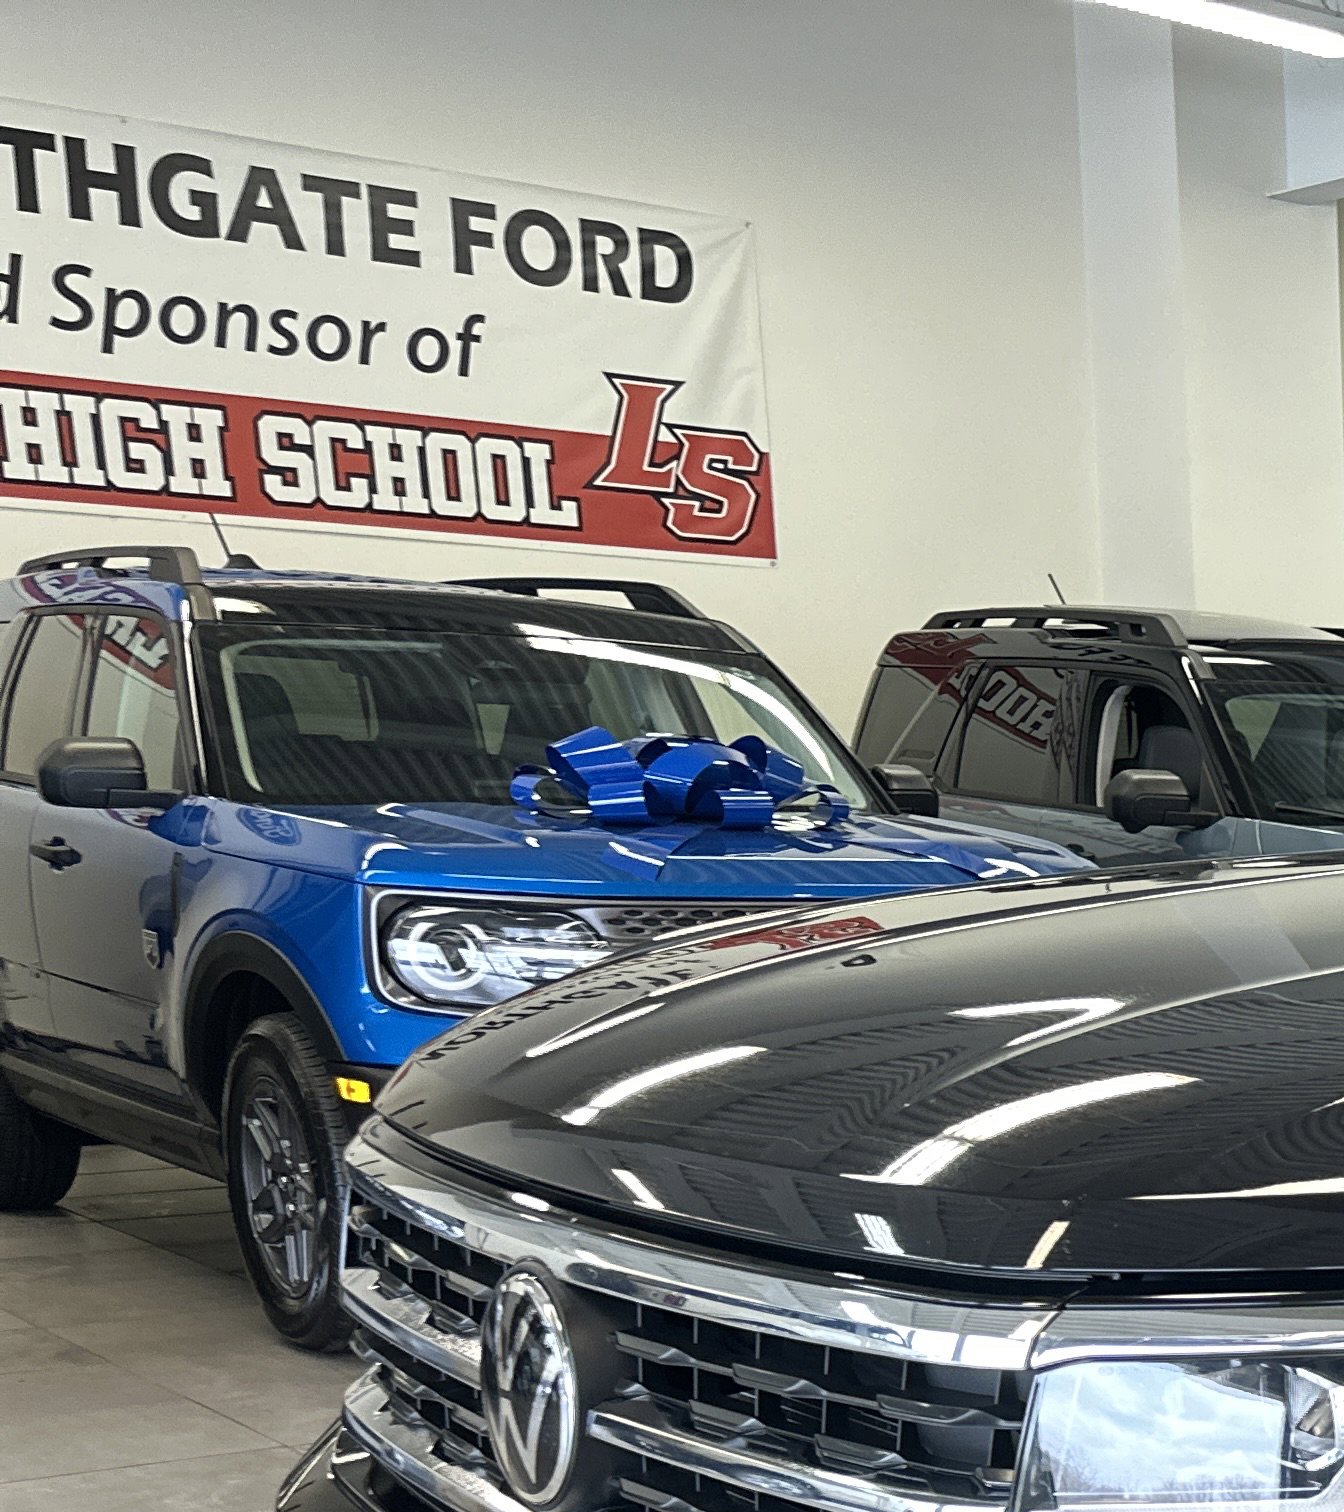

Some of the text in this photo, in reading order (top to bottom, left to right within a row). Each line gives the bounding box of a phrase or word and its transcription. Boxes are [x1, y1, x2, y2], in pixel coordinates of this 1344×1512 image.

[450, 195, 694, 304] FORD
[48, 263, 387, 367] Sponsor
[407, 312, 486, 378] of
[0, 388, 582, 529] HIGH SCHOOL
